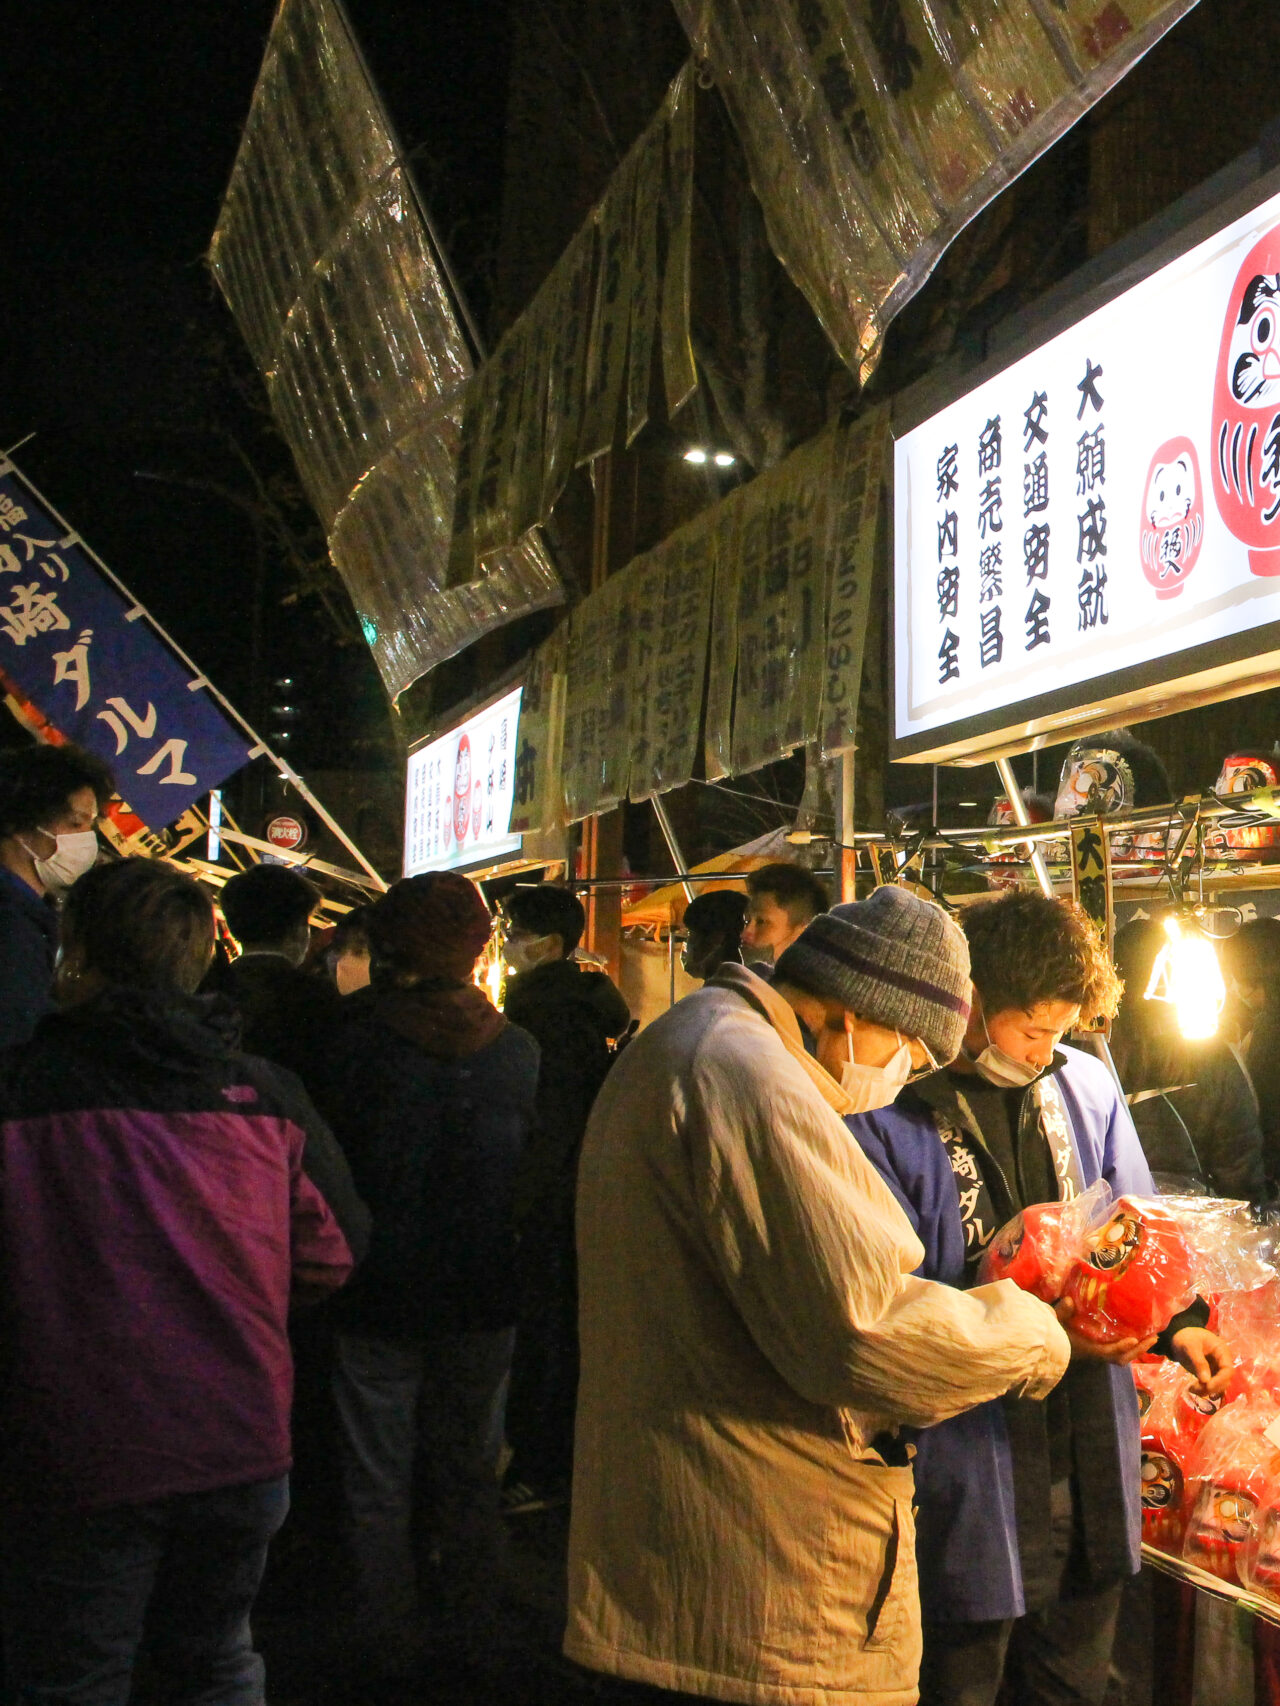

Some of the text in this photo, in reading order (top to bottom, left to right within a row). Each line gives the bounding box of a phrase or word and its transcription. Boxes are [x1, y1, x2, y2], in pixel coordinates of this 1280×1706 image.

[936, 444, 961, 684] 家内安全
[977, 414, 1003, 669] 商売繁昌
[1023, 390, 1052, 651] 交通安全
[1075, 358, 1110, 632] 大願成就
